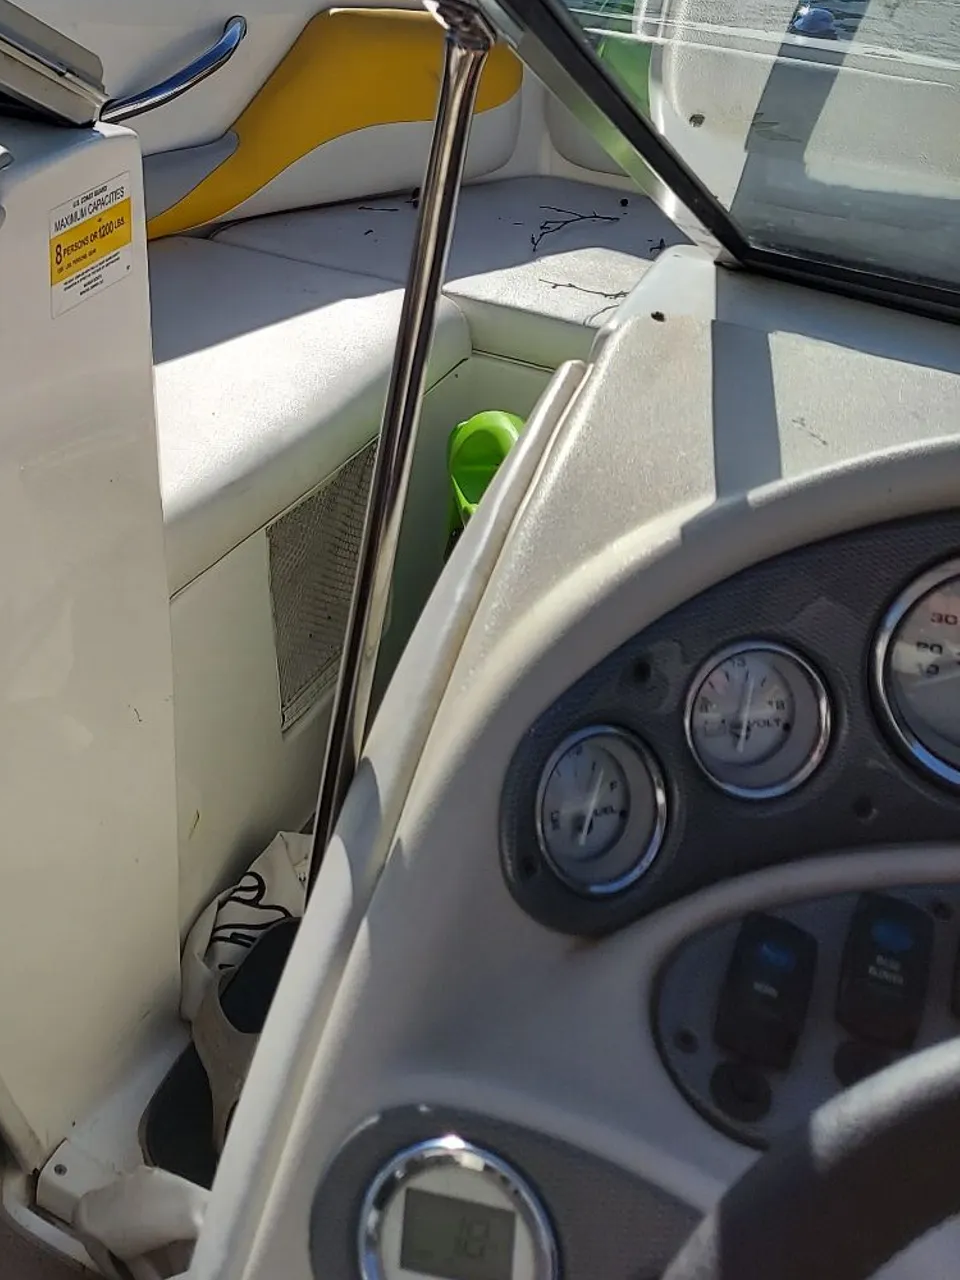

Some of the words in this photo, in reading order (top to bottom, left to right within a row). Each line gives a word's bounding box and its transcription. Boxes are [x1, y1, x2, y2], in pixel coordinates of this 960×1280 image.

[54, 209, 87, 232] MAXIMUM
[87, 186, 124, 214] CAPACITIES
[55, 243, 62, 265] 8
[63, 236, 89, 257] PERSONS
[89, 231, 98, 243] OR
[98, 220, 114, 239] 1200
[930, 612, 958, 625] 30
